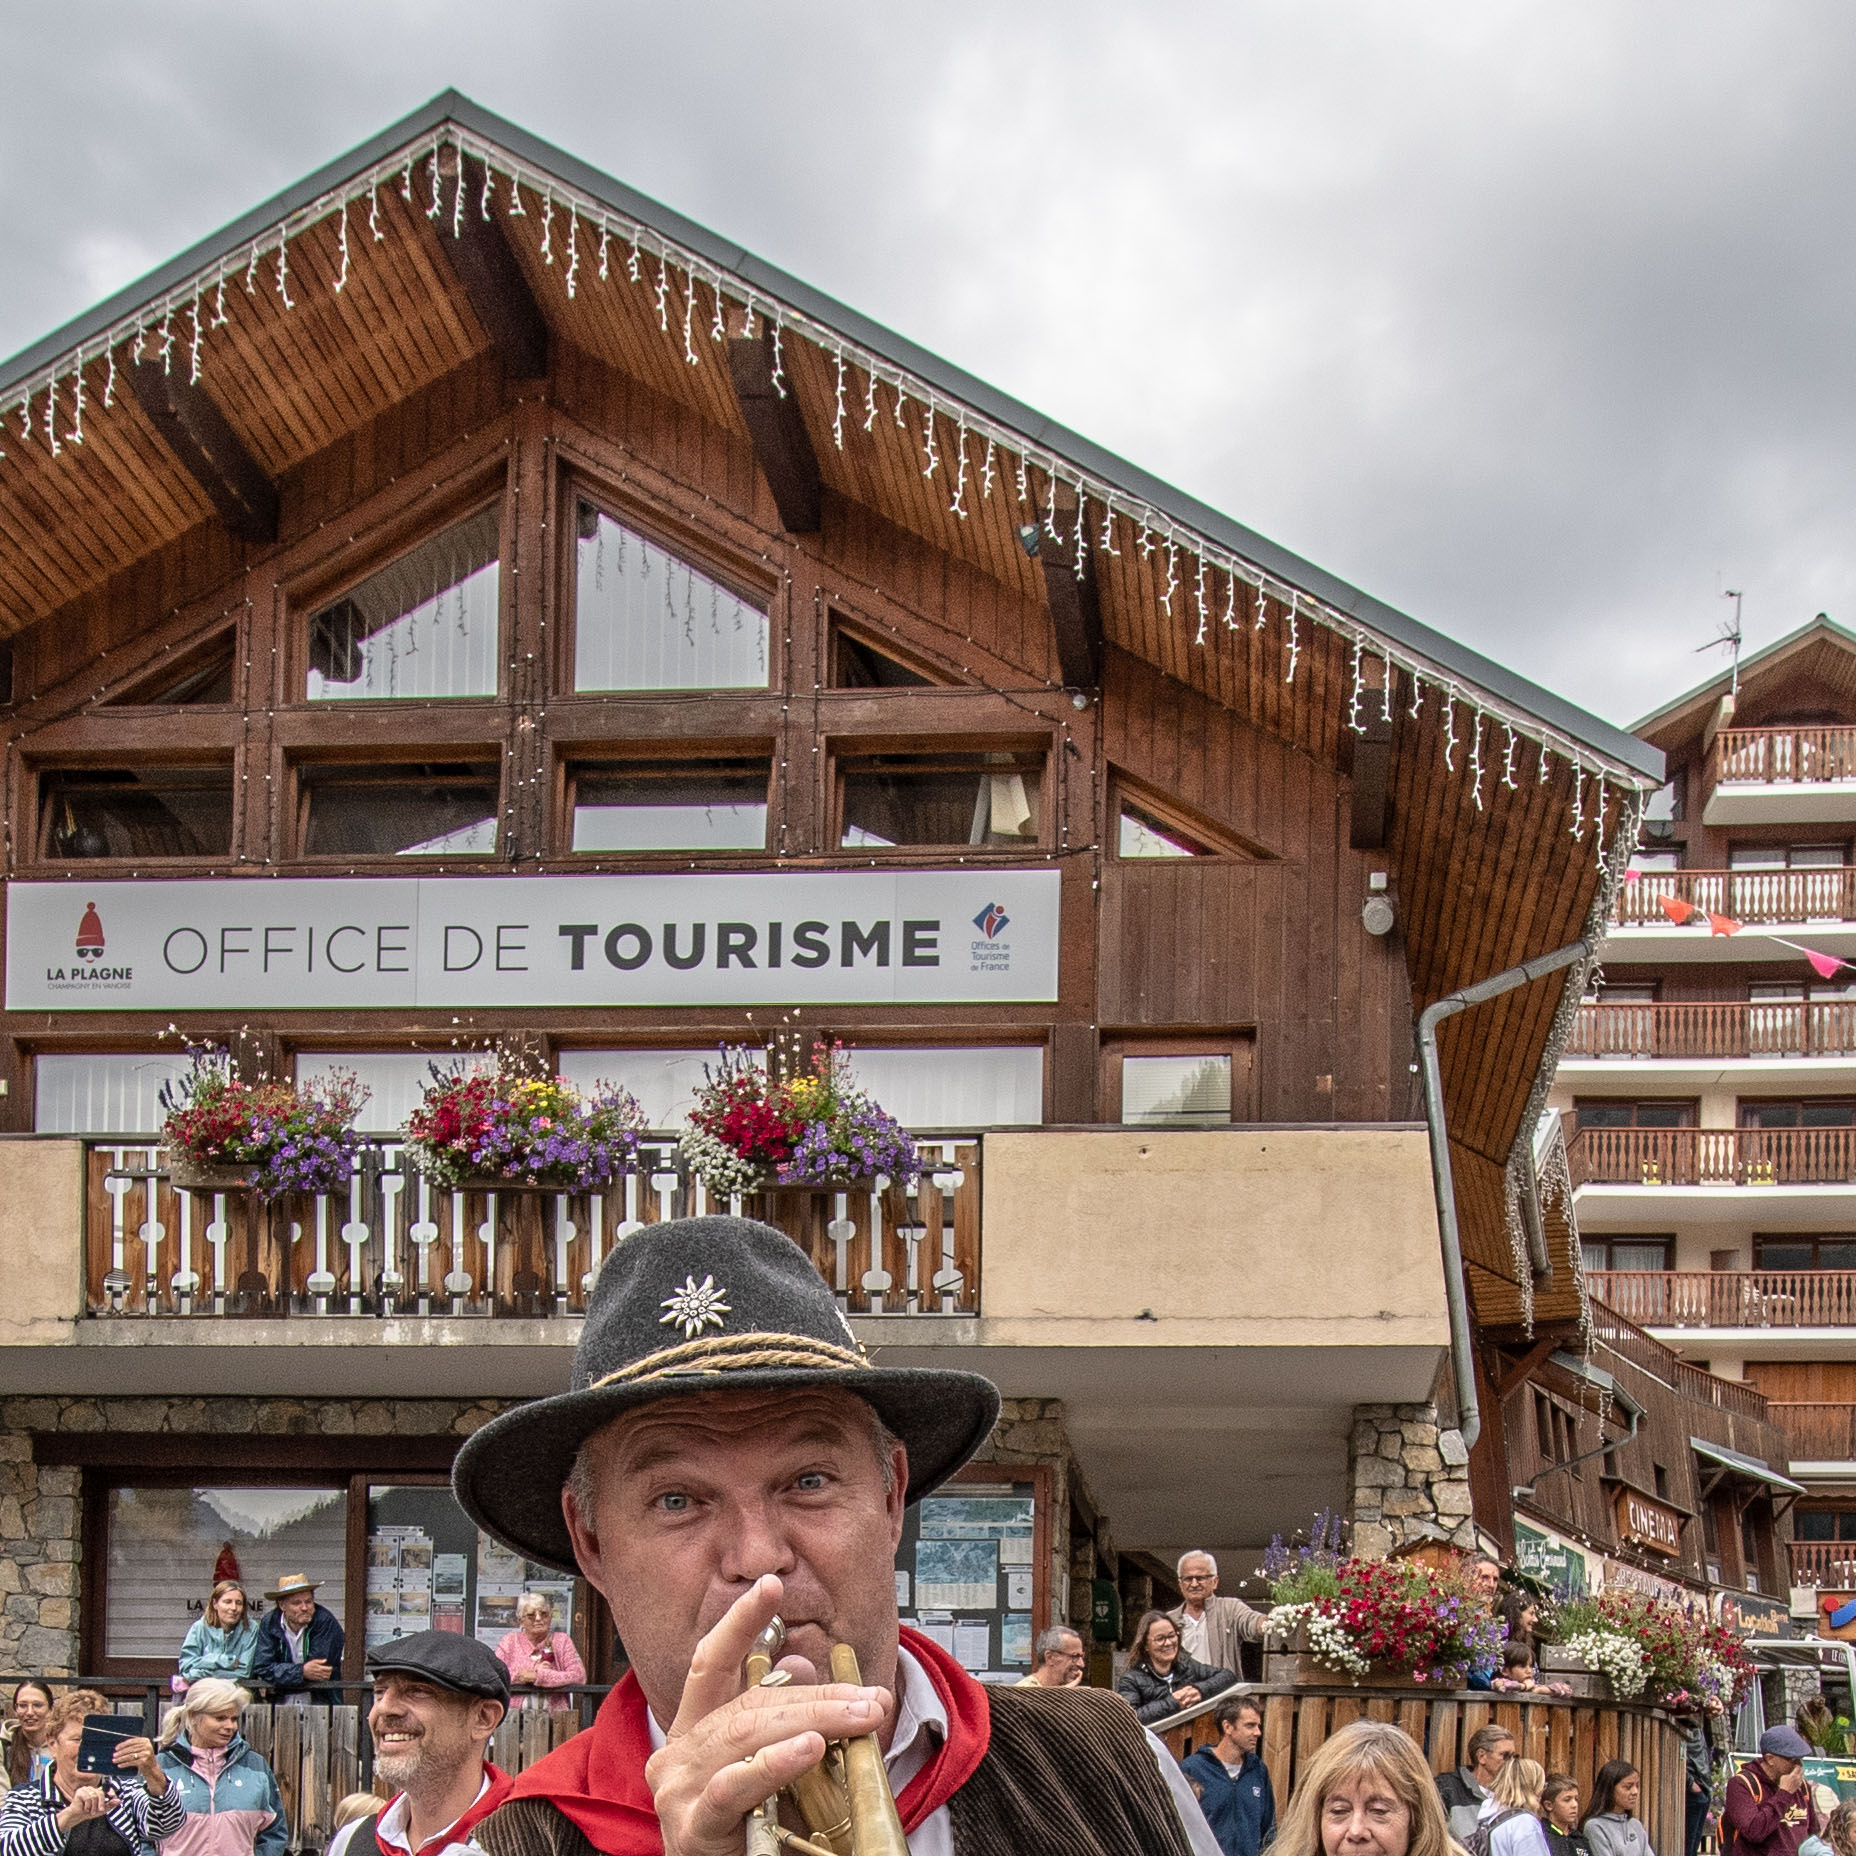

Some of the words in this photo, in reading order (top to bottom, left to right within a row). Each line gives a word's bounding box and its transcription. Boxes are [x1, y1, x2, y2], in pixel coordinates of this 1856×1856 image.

[163, 925, 410, 974] OFFICE
[443, 924, 529, 972] DE
[559, 920, 941, 970] TOURISME
[971, 941, 1000, 951] Offices
[971, 951, 1010, 961] Tourisme
[980, 961, 1010, 971] France
[47, 967, 66, 981] LA
[71, 967, 133, 981] PLAGNE
[47, 982, 91, 990] CHAMPAGNY
[1629, 1501, 1676, 1548] CINEMA
